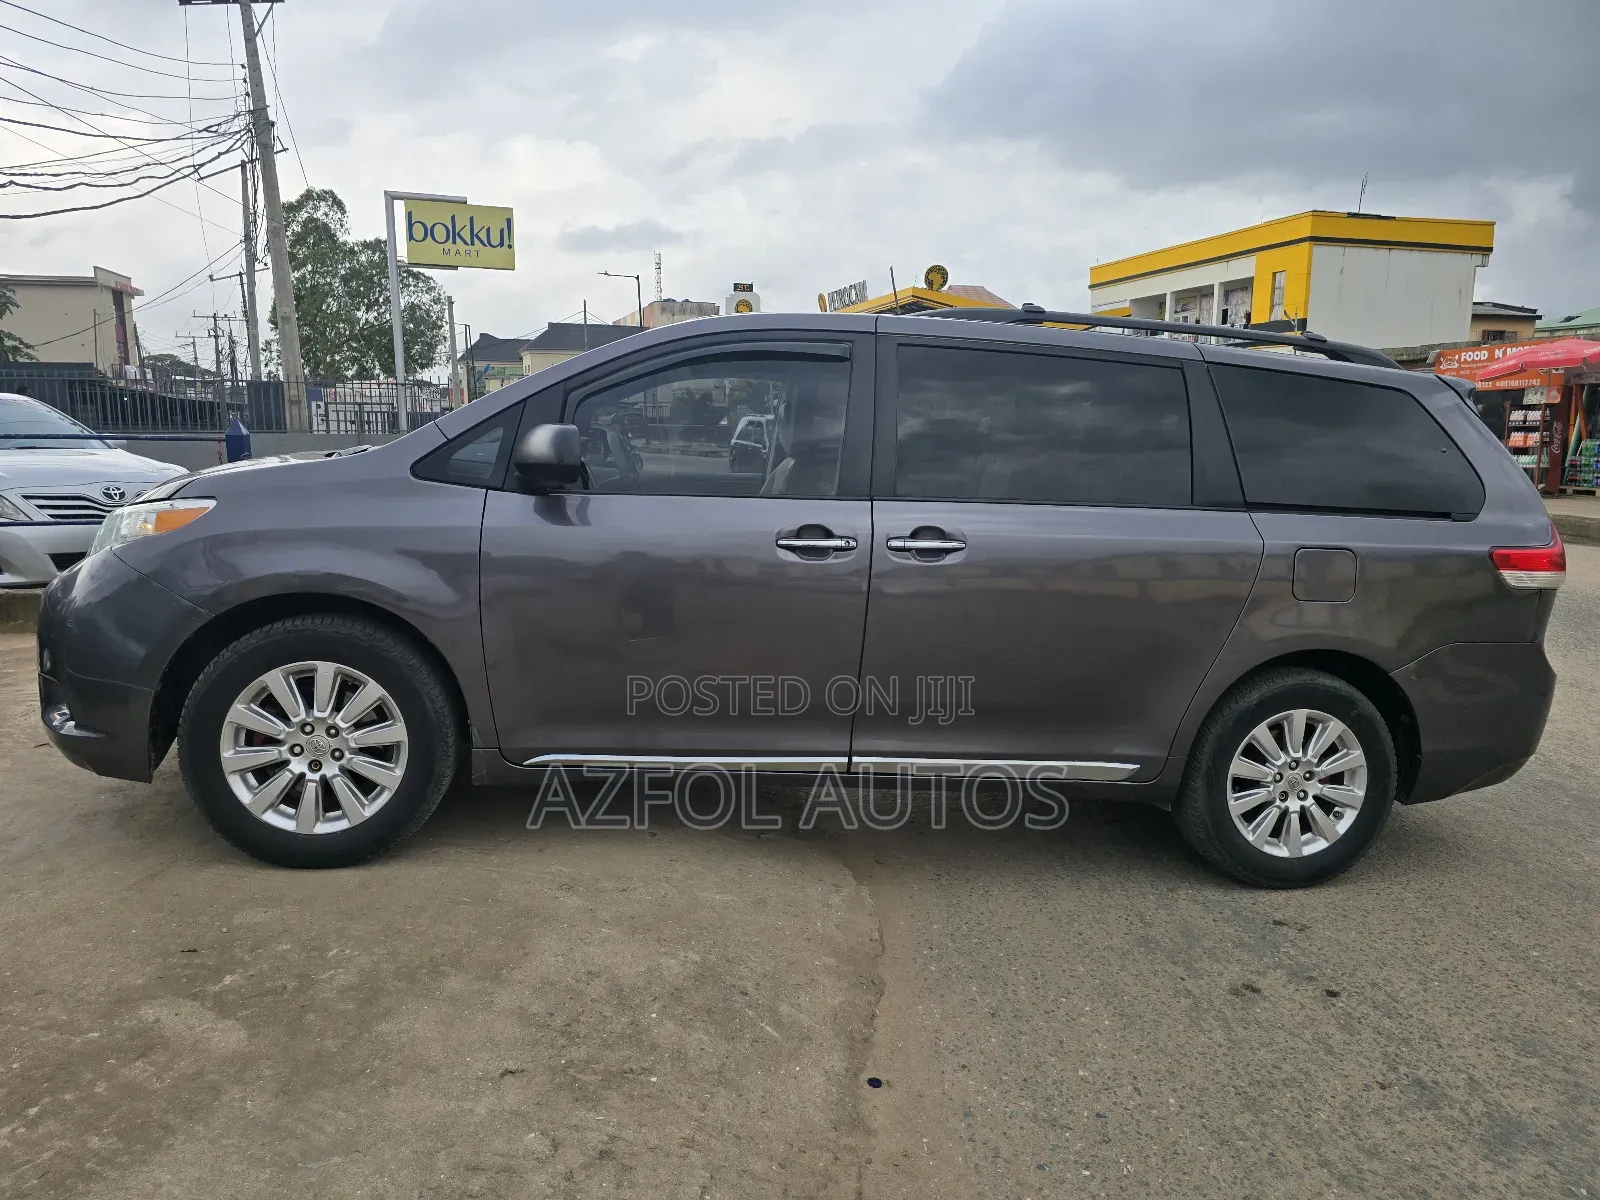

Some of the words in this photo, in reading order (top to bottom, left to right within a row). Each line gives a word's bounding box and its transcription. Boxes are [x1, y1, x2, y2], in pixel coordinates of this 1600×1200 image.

[407, 210, 513, 249] bokku!
[442, 247, 481, 258] MART
[1461, 350, 1488, 362] FOOD
